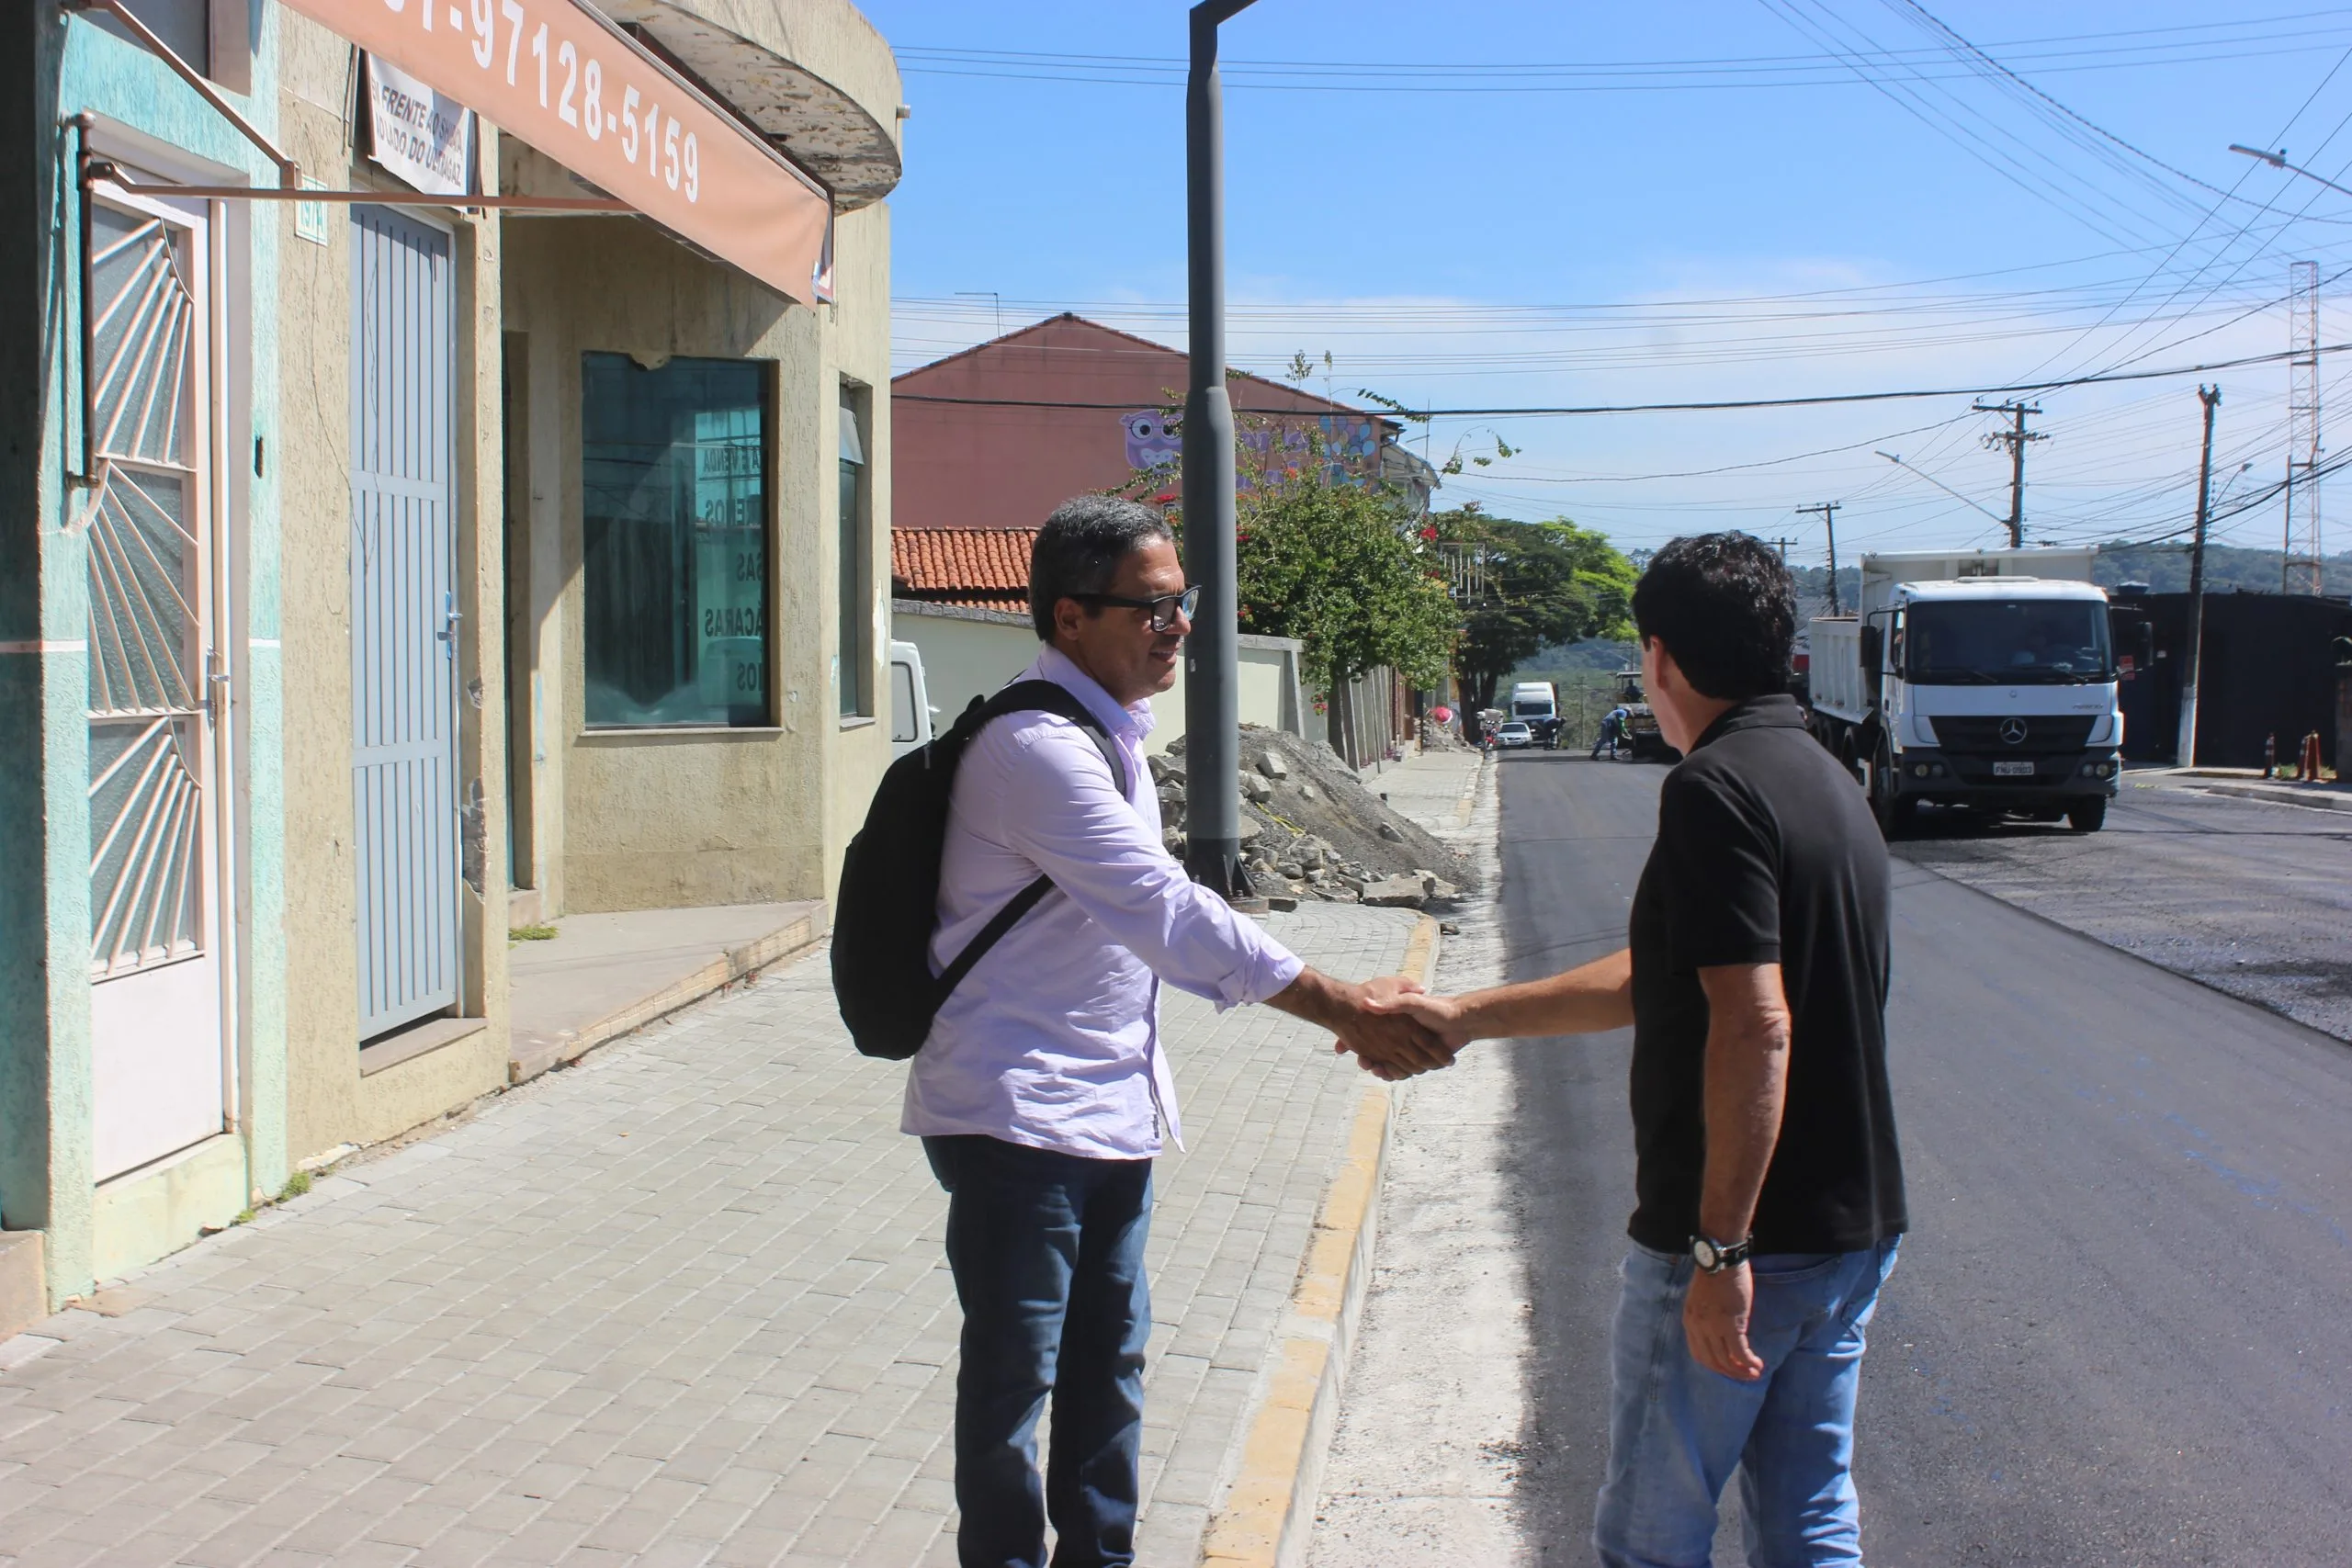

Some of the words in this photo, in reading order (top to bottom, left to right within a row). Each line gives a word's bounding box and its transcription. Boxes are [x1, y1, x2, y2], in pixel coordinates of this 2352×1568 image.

[382, 85, 426, 129] FRENTE
[384, 0, 698, 202] -97128-5159
[409, 136, 425, 164] DO
